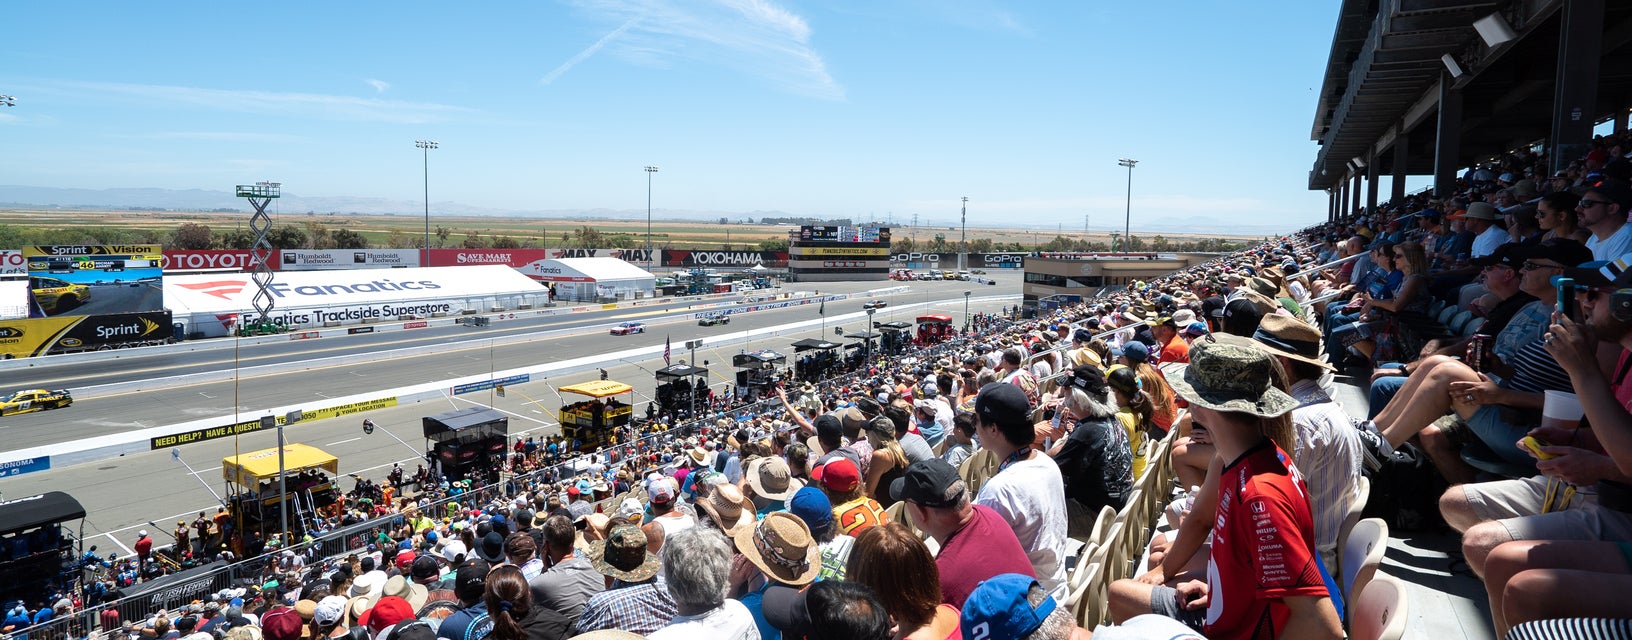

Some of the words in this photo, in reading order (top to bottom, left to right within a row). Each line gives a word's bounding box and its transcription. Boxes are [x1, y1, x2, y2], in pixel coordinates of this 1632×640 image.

[51, 246, 87, 254] Sprint
[112, 245, 151, 253] Vision
[618, 249, 652, 261] MAX
[173, 254, 263, 268] TOYOTA
[457, 253, 483, 263] SAVE
[691, 252, 763, 264] YOKOHAMA
[984, 254, 1022, 263] GoPro
[540, 266, 561, 274] Fanatics
[267, 279, 442, 298] Fanatics
[243, 312, 309, 327] Faatics
[313, 306, 380, 323] Trackside
[382, 302, 450, 318] Superstore
[96, 324, 140, 339] Sprint
[358, 403, 386, 412] LOCATION
[155, 437, 177, 447] NEED
[178, 432, 202, 442] HELP?
[206, 427, 225, 438] HAVE
[227, 426, 233, 434] A
